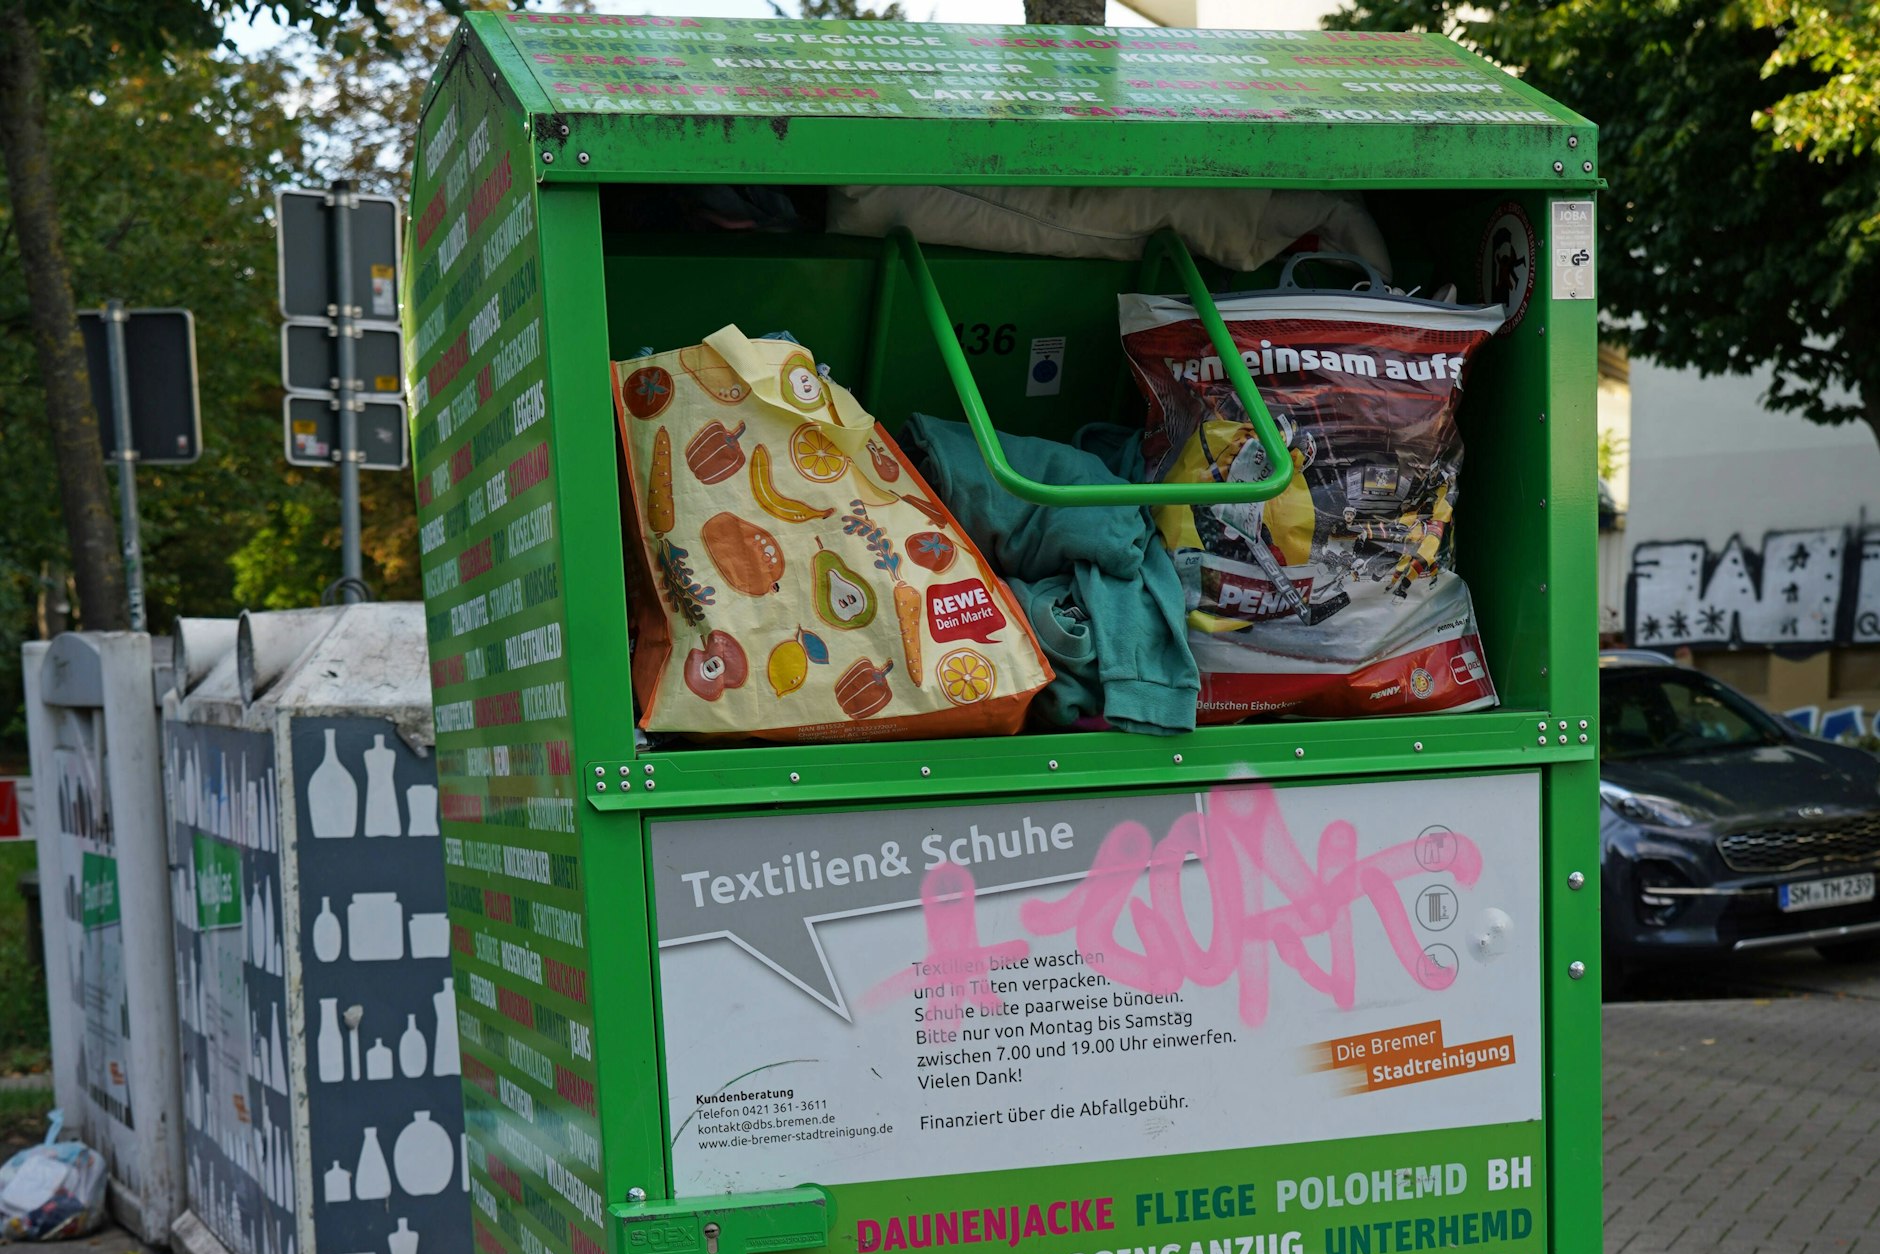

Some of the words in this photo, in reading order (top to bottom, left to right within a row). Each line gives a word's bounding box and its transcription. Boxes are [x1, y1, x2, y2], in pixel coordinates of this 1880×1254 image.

[506, 14, 702, 28] FEDERBOA
[726, 20, 827, 30] ROCK
[847, 22, 1067, 36] UNTERHEMD
[1085, 27, 1307, 41] WONDERBRA
[1322, 32, 1423, 44] JEANS
[514, 26, 727, 41] POLOHEMD
[753, 33, 947, 46] STEGHOSE
[967, 37, 1199, 51] NECKHOLDER
[1220, 41, 1440, 55] MOONBOOTS
[532, 54, 687, 67] STRAPS
[712, 58, 1032, 74] KNICKERBOCKER
[1054, 65, 1217, 77] HIPSTER
[823, 47, 1098, 62] WINDBREAKER
[1118, 53, 1271, 65] KIMONO
[1292, 56, 1467, 68] REITHOSE
[552, 82, 880, 99] SCHNUFFELTUCH
[908, 88, 1104, 102] LATZHOSE
[1125, 79, 1320, 92] BABYDOLL
[1341, 82, 1506, 94] STRUMPF
[1316, 109, 1558, 122] ROLLSCHUHE
[1560, 211, 1587, 221] JOBA
[512, 378, 545, 438] LEGGINS
[506, 503, 554, 560] ACHSELSHIRT
[933, 588, 989, 616] REWE
[936, 617, 960, 630] Dein
[961, 607, 994, 625] Markt
[505, 622, 562, 671] PAILLETTENKLEID
[521, 681, 566, 722] WICKELROCK
[1196, 700, 1248, 711] Deutschen
[545, 740, 571, 776] TANGA
[921, 817, 1075, 871] Schuhe
[531, 900, 583, 950] SCHOTTENROCK
[989, 954, 1029, 971] bitte
[1033, 949, 1105, 967] waschen
[914, 982, 945, 999] und
[950, 980, 965, 996] in
[970, 977, 1018, 995] Tüten
[1022, 972, 1111, 993] verpacken.
[914, 1003, 975, 1022] Schuhe
[979, 1000, 1020, 1018] bitte
[1024, 996, 1108, 1018] paarweise
[1112, 990, 1184, 1007] bündeln.
[569, 1018, 591, 1068] JEANS
[916, 1028, 958, 1045] Bitte
[962, 1027, 990, 1041] nur
[995, 1025, 1024, 1039] von
[1030, 1019, 1093, 1037] Montag
[1098, 1015, 1121, 1031] bis
[1125, 1012, 1192, 1030] Samstag
[917, 1049, 991, 1067] zwischen
[996, 1046, 1032, 1061] 7.00
[1036, 1042, 1066, 1059] und
[1071, 1039, 1114, 1056] 19.00
[1118, 1036, 1149, 1051] Uhr
[1153, 1030, 1237, 1048] einwerfen.
[1336, 1041, 1365, 1062] Die
[1371, 1030, 1436, 1057] Bremer
[1372, 1044, 1511, 1083] Stadtreinigung
[918, 1072, 971, 1090] Vielen
[976, 1068, 1023, 1086] Dank!
[696, 1087, 794, 1104] Kundenberatung
[696, 1105, 740, 1119] Telefon
[742, 1103, 769, 1117] 0421
[697, 1112, 836, 1134] kontakt@dbs.bremen.de
[921, 1110, 1003, 1130] Finanziert
[1008, 1107, 1046, 1124] über
[1050, 1104, 1076, 1121] die
[1080, 1096, 1188, 1118] Abfallgebühr.
[698, 1122, 893, 1149] www.die-bremer-stadtreinigung.de
[857, 1198, 1114, 1253] DAUNENJACKE
[1136, 1184, 1256, 1226] FLIEGE
[1277, 1163, 1467, 1212] POLOHEMD
[1488, 1157, 1532, 1191] BH
